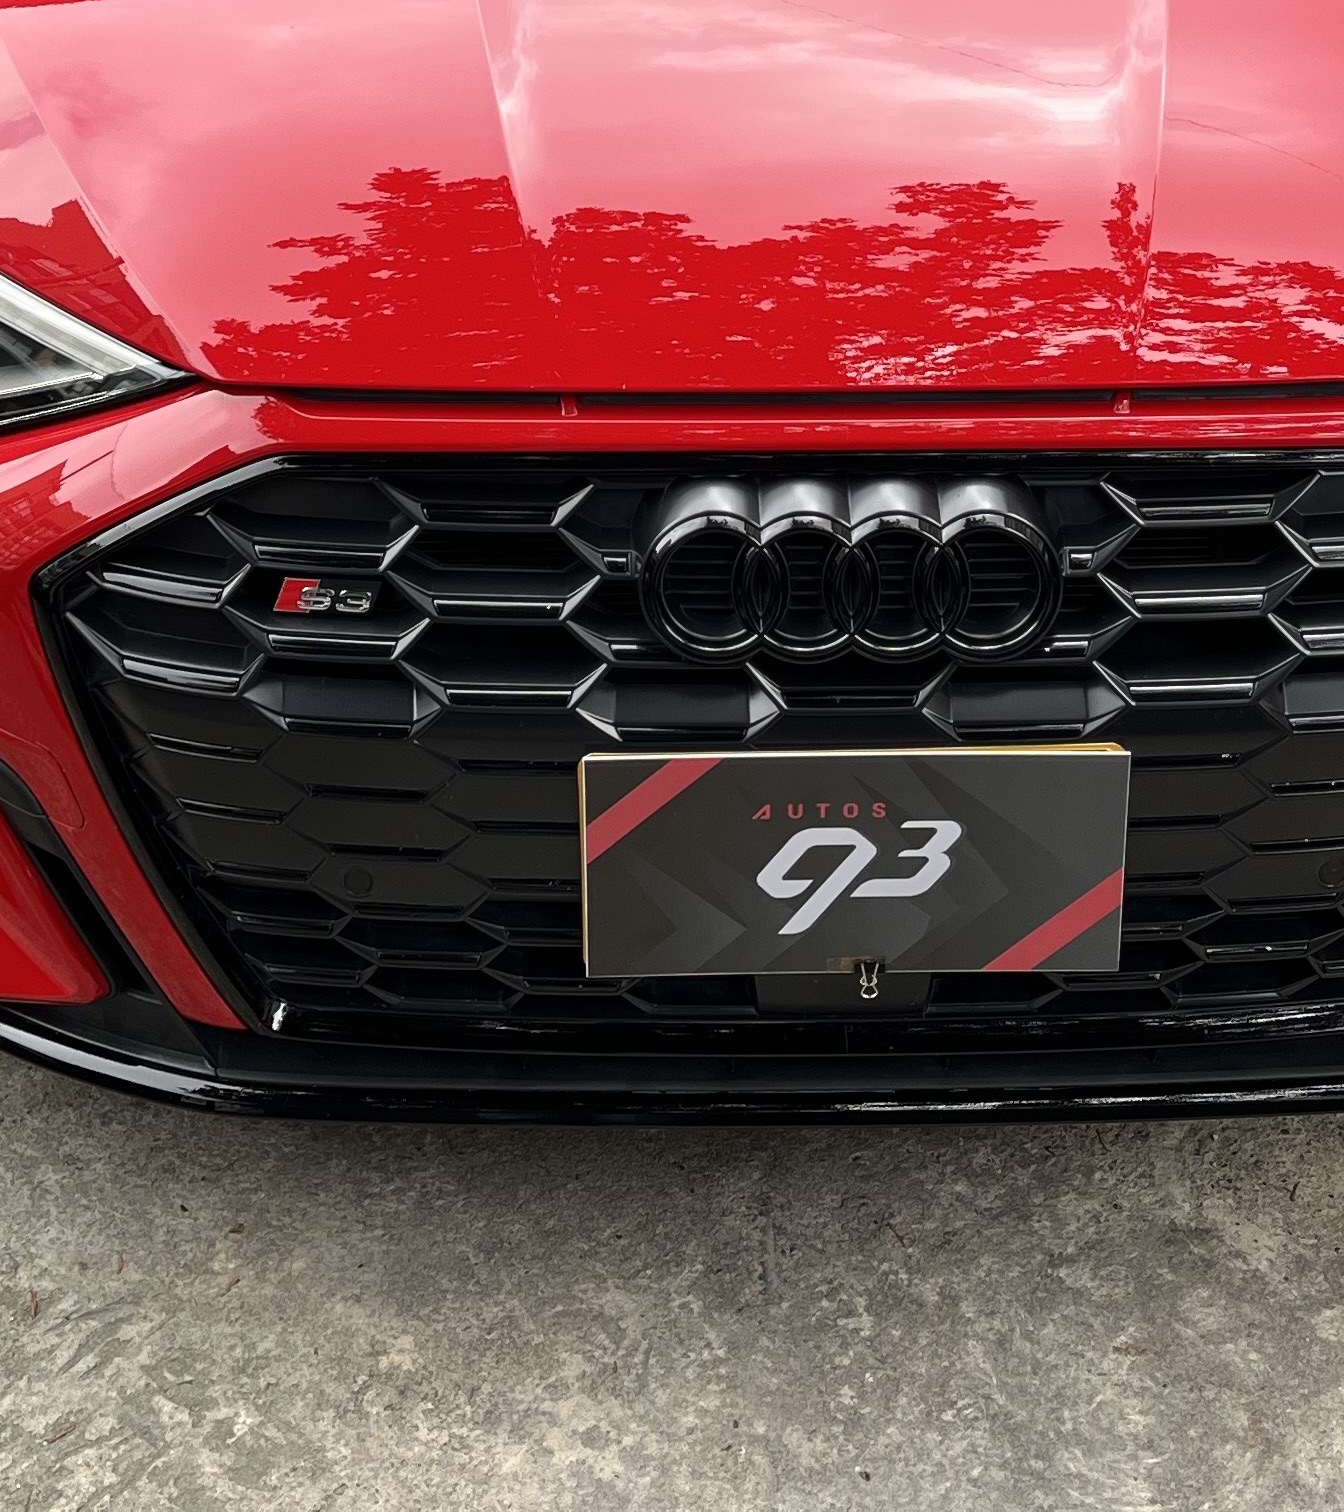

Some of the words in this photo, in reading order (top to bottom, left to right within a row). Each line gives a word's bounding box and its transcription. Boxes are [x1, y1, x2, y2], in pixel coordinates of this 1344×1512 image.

[296, 585, 372, 613] S3
[751, 801, 888, 821] AUTOS
[756, 819, 963, 936] 93
